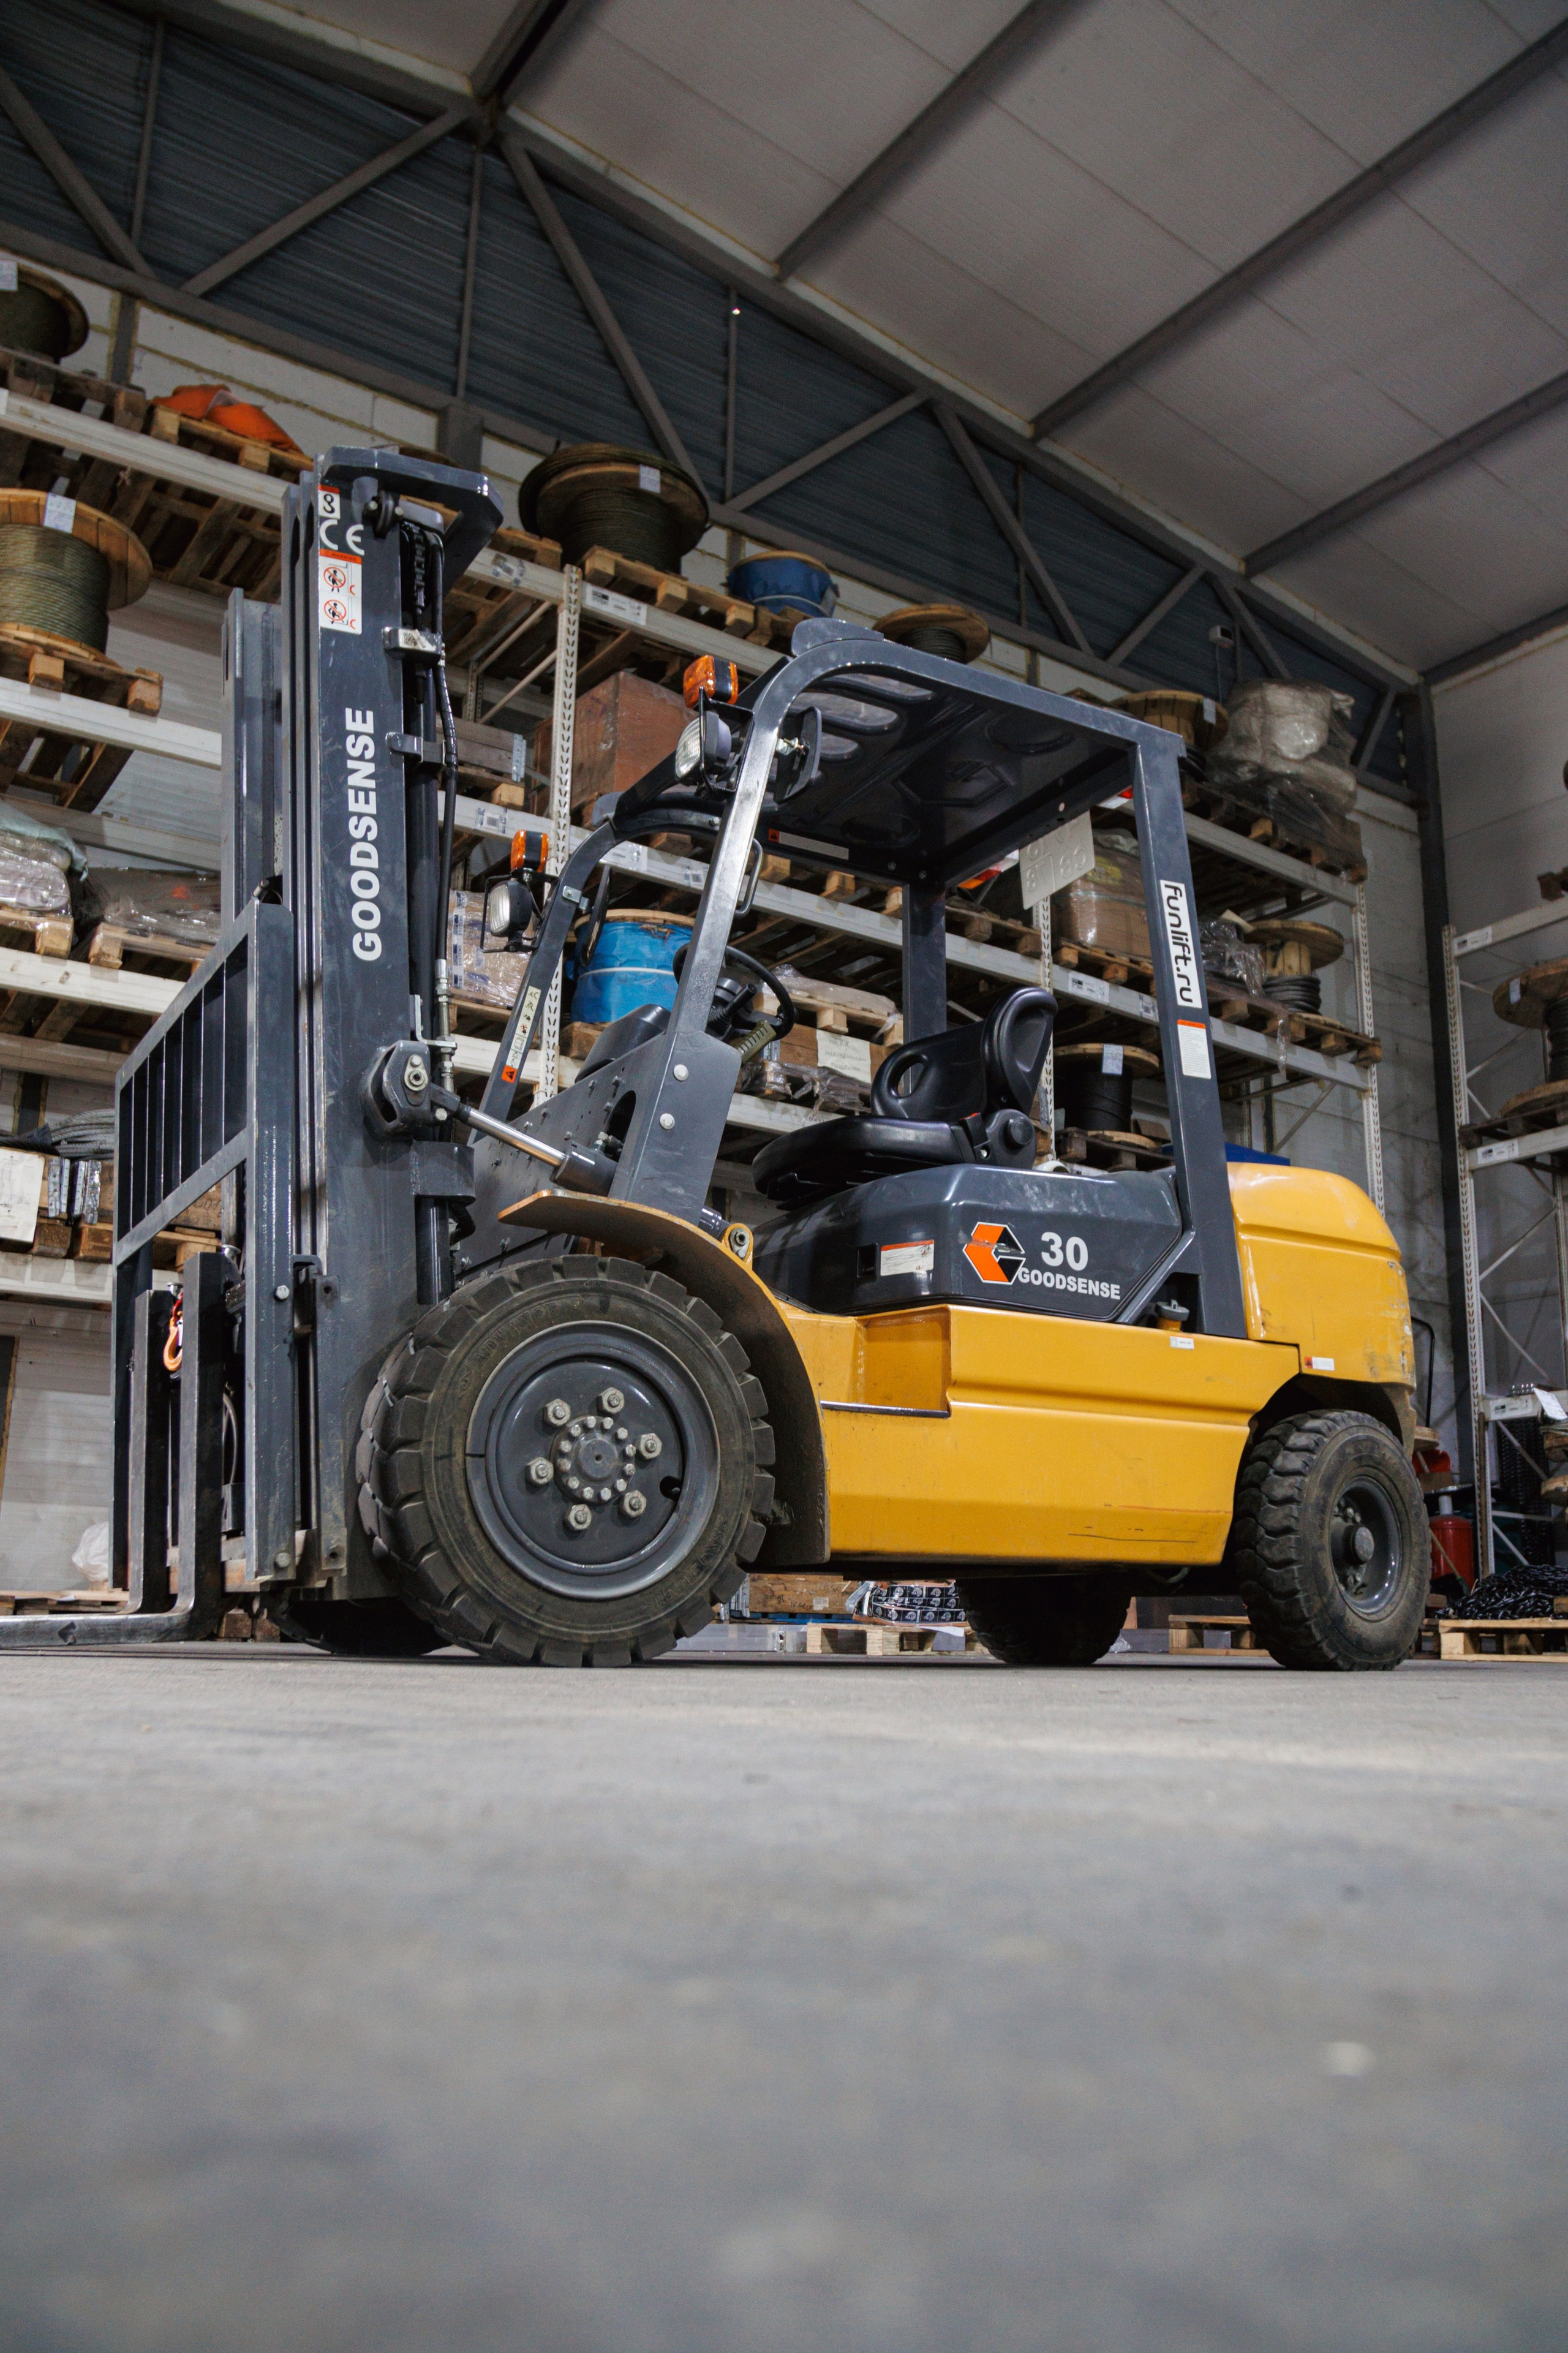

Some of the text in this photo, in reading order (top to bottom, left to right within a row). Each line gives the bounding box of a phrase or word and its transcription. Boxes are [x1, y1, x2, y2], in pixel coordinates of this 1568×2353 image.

[320, 519, 364, 556] CE
[331, 552, 357, 562] WARNING
[345, 708, 382, 961] GOODSENSE
[1164, 883, 1193, 1003] funlift.ru
[1041, 1231, 1088, 1271] 30
[1017, 1267, 1121, 1300] GOODSENSE
[473, 1301, 560, 1363] ADVANCE
